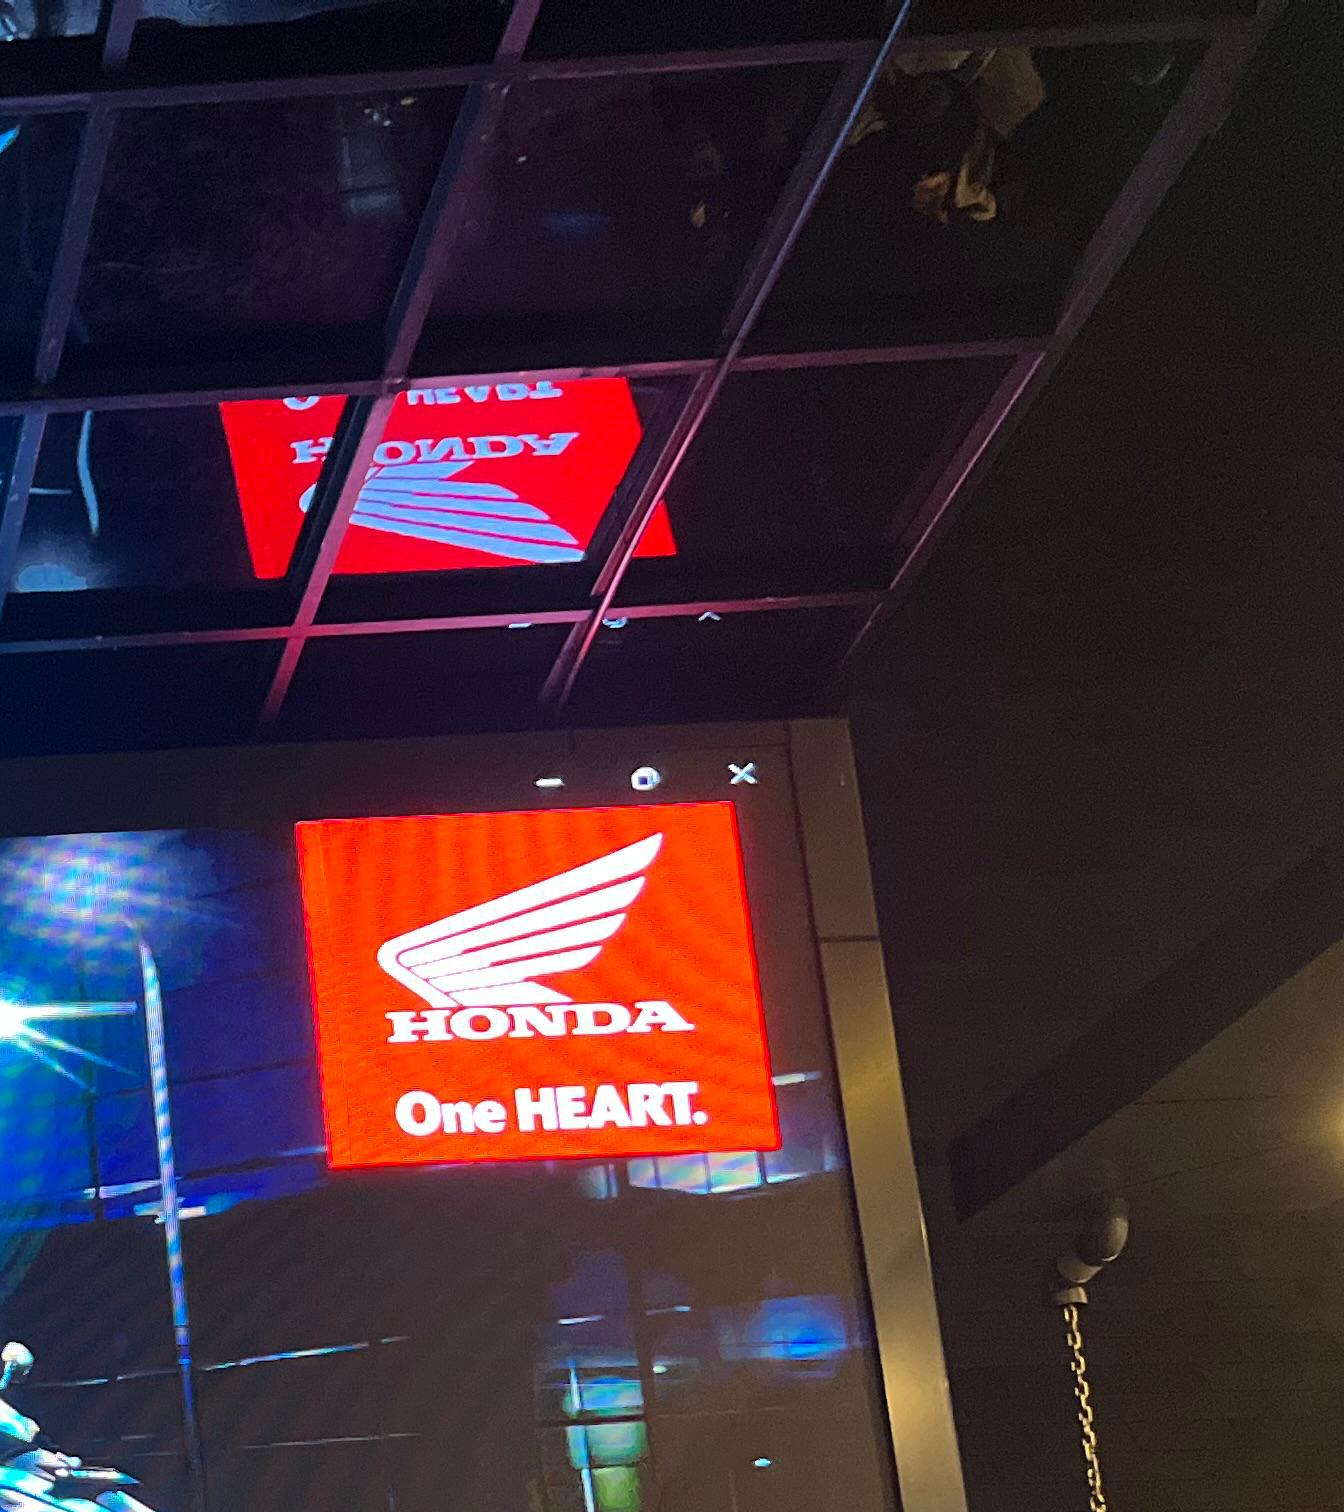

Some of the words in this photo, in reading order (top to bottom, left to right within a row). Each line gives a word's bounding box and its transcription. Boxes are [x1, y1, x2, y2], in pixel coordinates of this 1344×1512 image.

[386, 1000, 695, 1044] HONDA
[395, 1090, 508, 1136] One
[515, 1081, 709, 1134] HEART.
